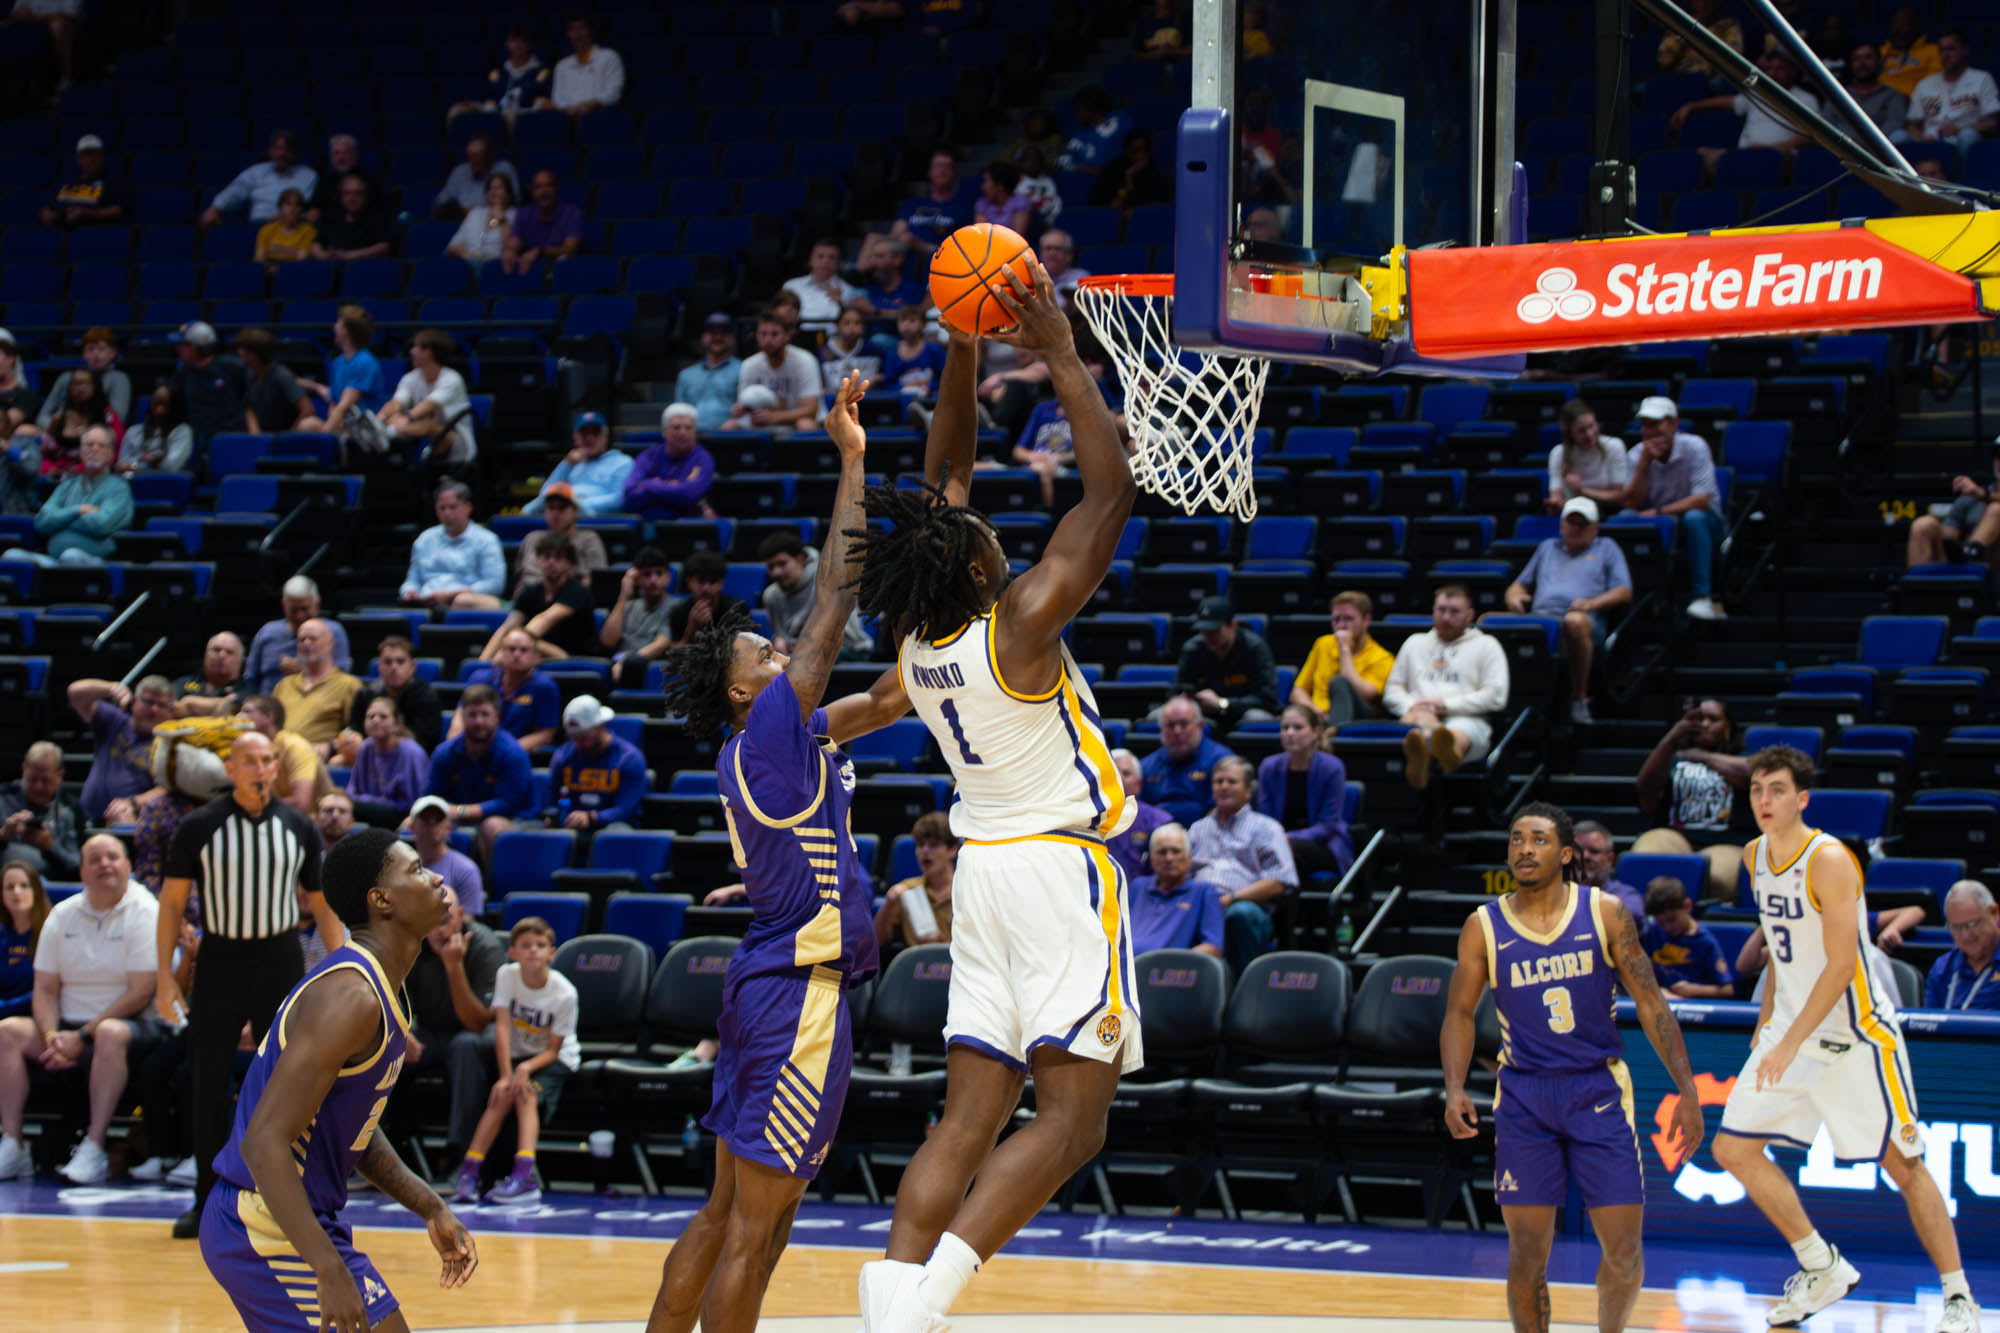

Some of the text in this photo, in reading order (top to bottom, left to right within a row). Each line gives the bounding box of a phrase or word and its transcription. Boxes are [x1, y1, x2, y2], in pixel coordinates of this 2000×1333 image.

[940, 698, 983, 765] 1
[562, 767, 619, 792] LSU
[1756, 890, 1804, 920] LSU
[1771, 925, 1793, 964] 3
[1510, 950, 1593, 988] ALCORN
[510, 998, 553, 1028] LSU
[1542, 986, 1575, 1034] 3
